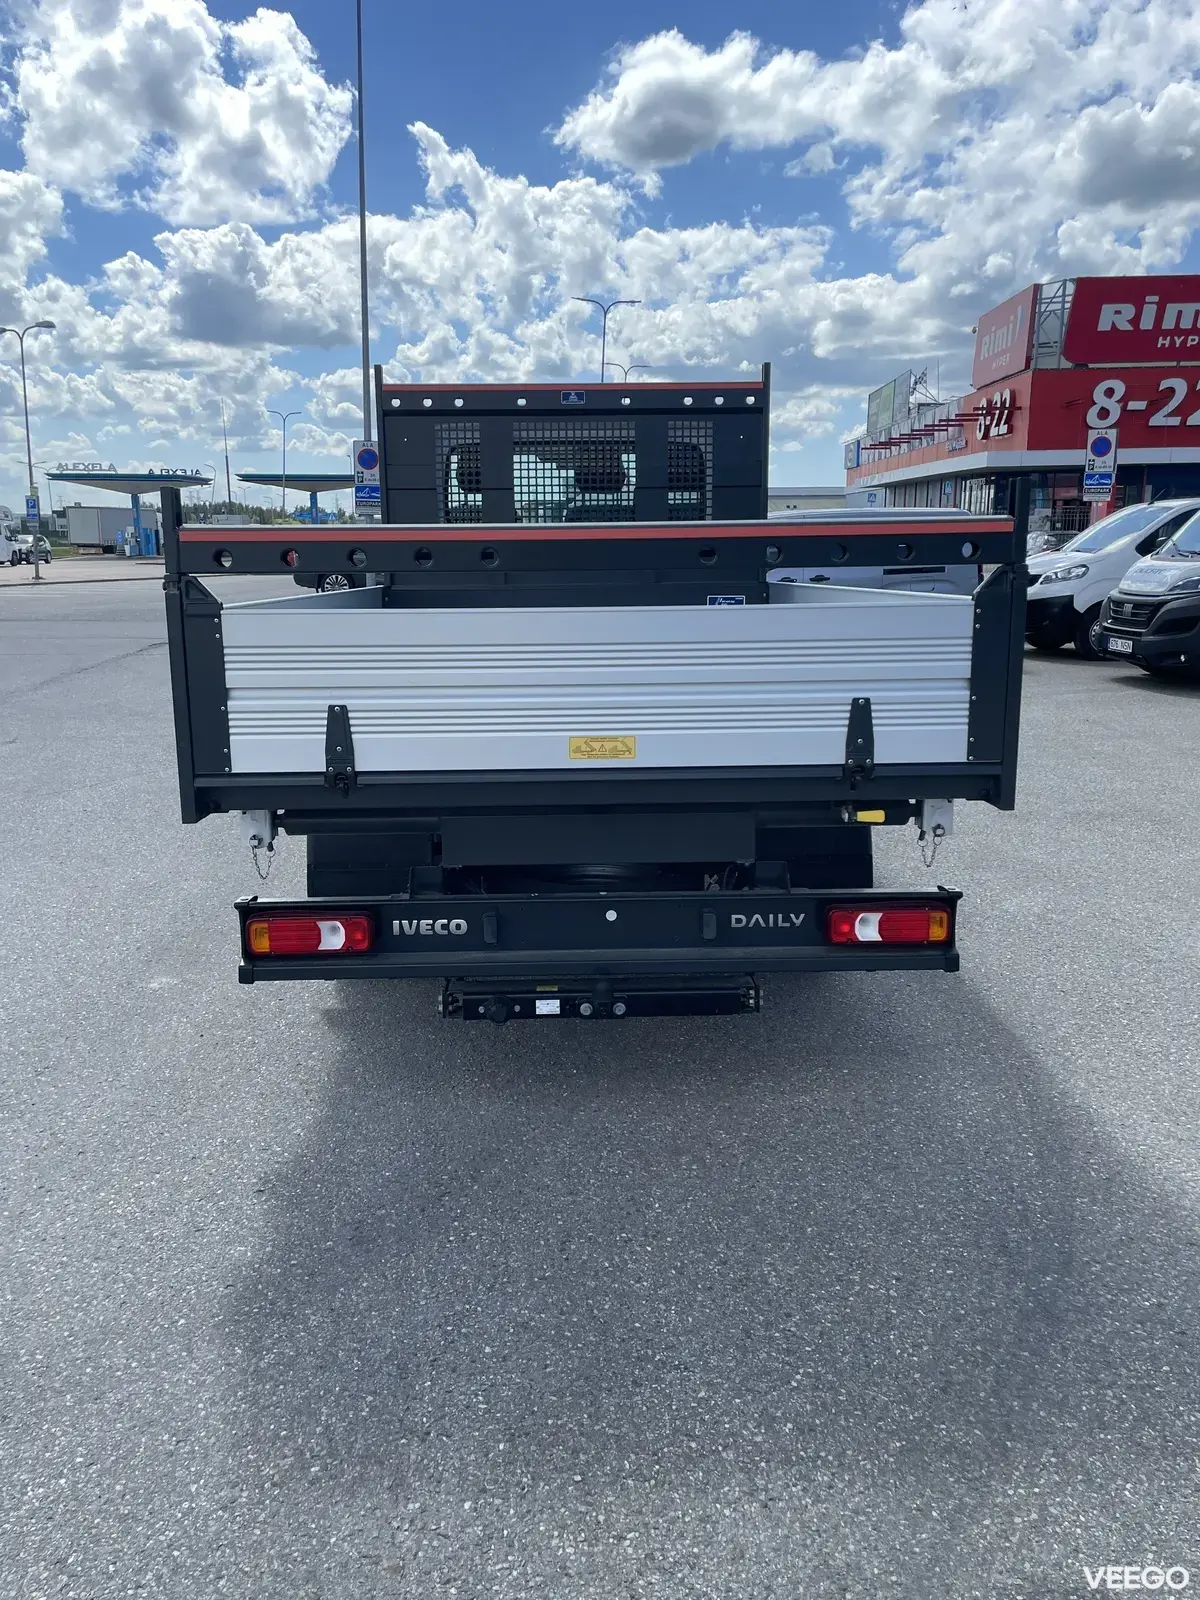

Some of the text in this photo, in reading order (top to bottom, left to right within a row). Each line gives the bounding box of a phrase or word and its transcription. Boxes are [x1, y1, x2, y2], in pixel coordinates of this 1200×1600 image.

[981, 315, 1014, 361] Rimi
[976, 388, 1011, 440] 8-22
[55, 462, 118, 474] ALEXELA
[392, 919, 468, 936] IVECO
[730, 913, 806, 928] DAILY
